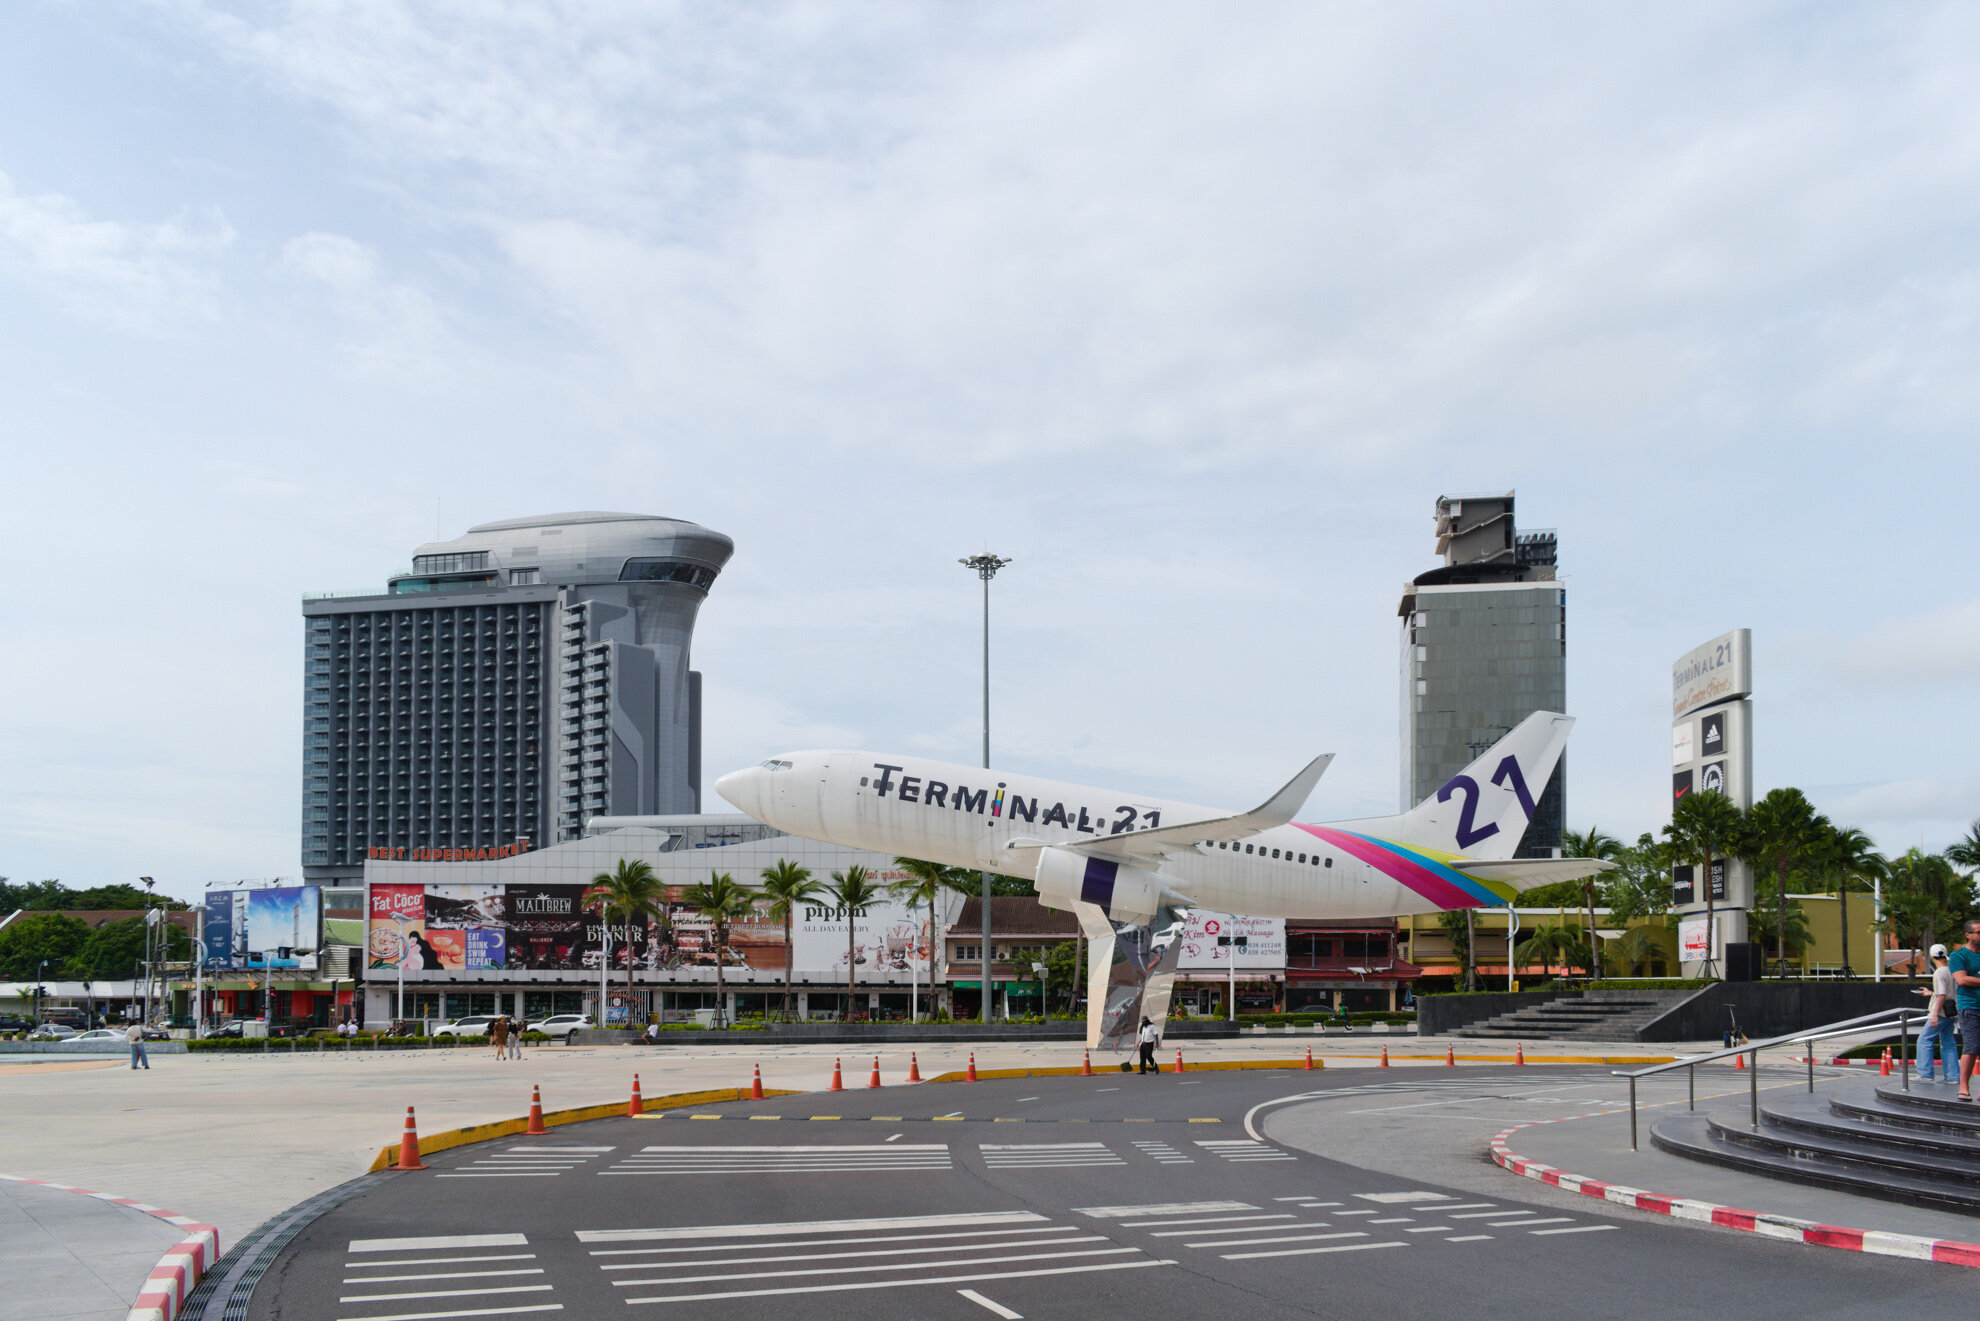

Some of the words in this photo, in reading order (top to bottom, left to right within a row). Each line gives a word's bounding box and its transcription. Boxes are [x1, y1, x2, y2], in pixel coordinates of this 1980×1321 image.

[1716, 641, 1731, 667] 21
[1705, 735, 1721, 744] adidas
[1437, 753, 1537, 850] 21
[1110, 805, 1162, 835] 21
[368, 847, 405, 859] BEST
[412, 840, 529, 861] SUPERMARKET
[372, 896, 391, 912] Fat
[516, 899, 572, 912] MALIBREW
[1183, 929, 1205, 940] Kim
[1246, 929, 1274, 937] Massage
[468, 941, 489, 949] DRINK
[468, 949, 487, 957] SWIM
[468, 958, 492, 966] REPEAT
